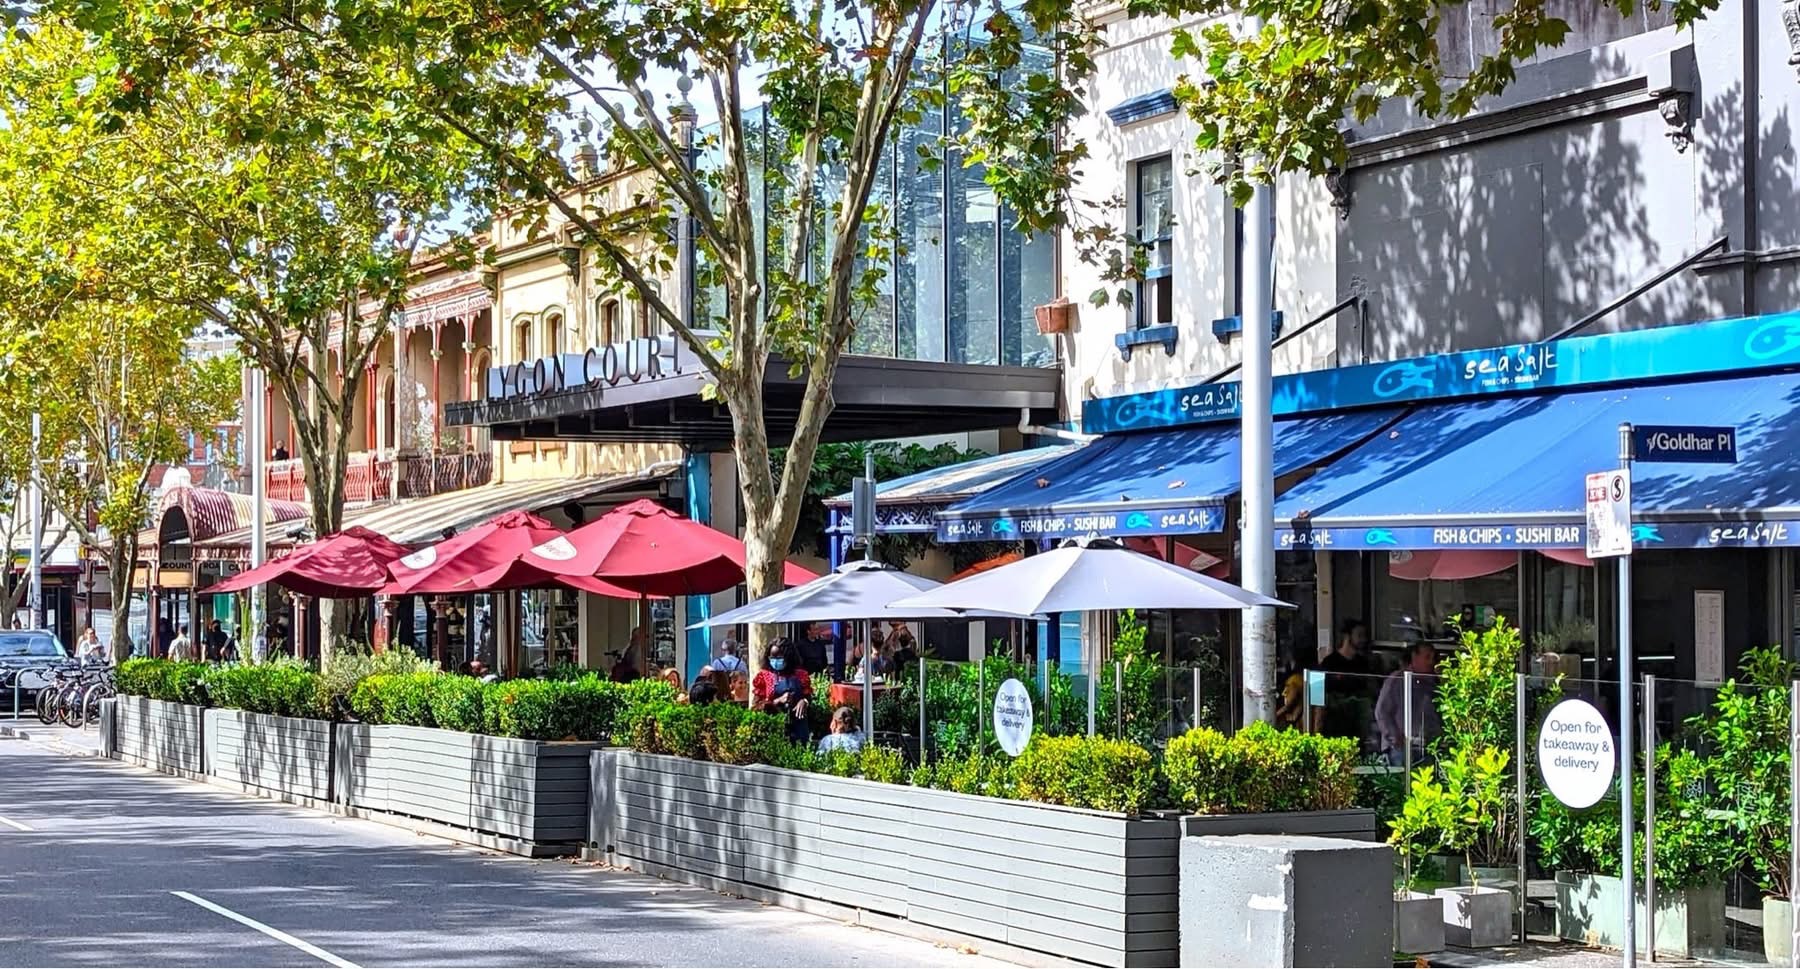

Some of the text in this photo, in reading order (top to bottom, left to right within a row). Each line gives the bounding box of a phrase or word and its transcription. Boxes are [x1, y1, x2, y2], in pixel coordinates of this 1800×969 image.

[487, 332, 682, 401] LYGON COURT
[1464, 359, 1509, 379] sea
[1181, 392, 1213, 411] sea
[1657, 432, 1731, 450] Goldhar Pl
[1073, 516, 1098, 531] SUSHI
[1099, 515, 1116, 529] BAR
[1161, 515, 1185, 528] sea
[947, 524, 965, 536] sea
[1433, 528, 1458, 544] FISH
[1469, 528, 1501, 543] CHIPS
[1515, 527, 1551, 543] SUSHI
[1554, 527, 1580, 543] BAR
[1709, 527, 1749, 543] sea
[1281, 533, 1306, 546] sea
[1000, 692, 1027, 703] Open for
[997, 706, 1025, 719] takeaway
[1002, 718, 1025, 731] delivery
[1550, 719, 1602, 735] Open for
[1543, 738, 1610, 755] takeaway &
[1554, 755, 1599, 773] delivery
